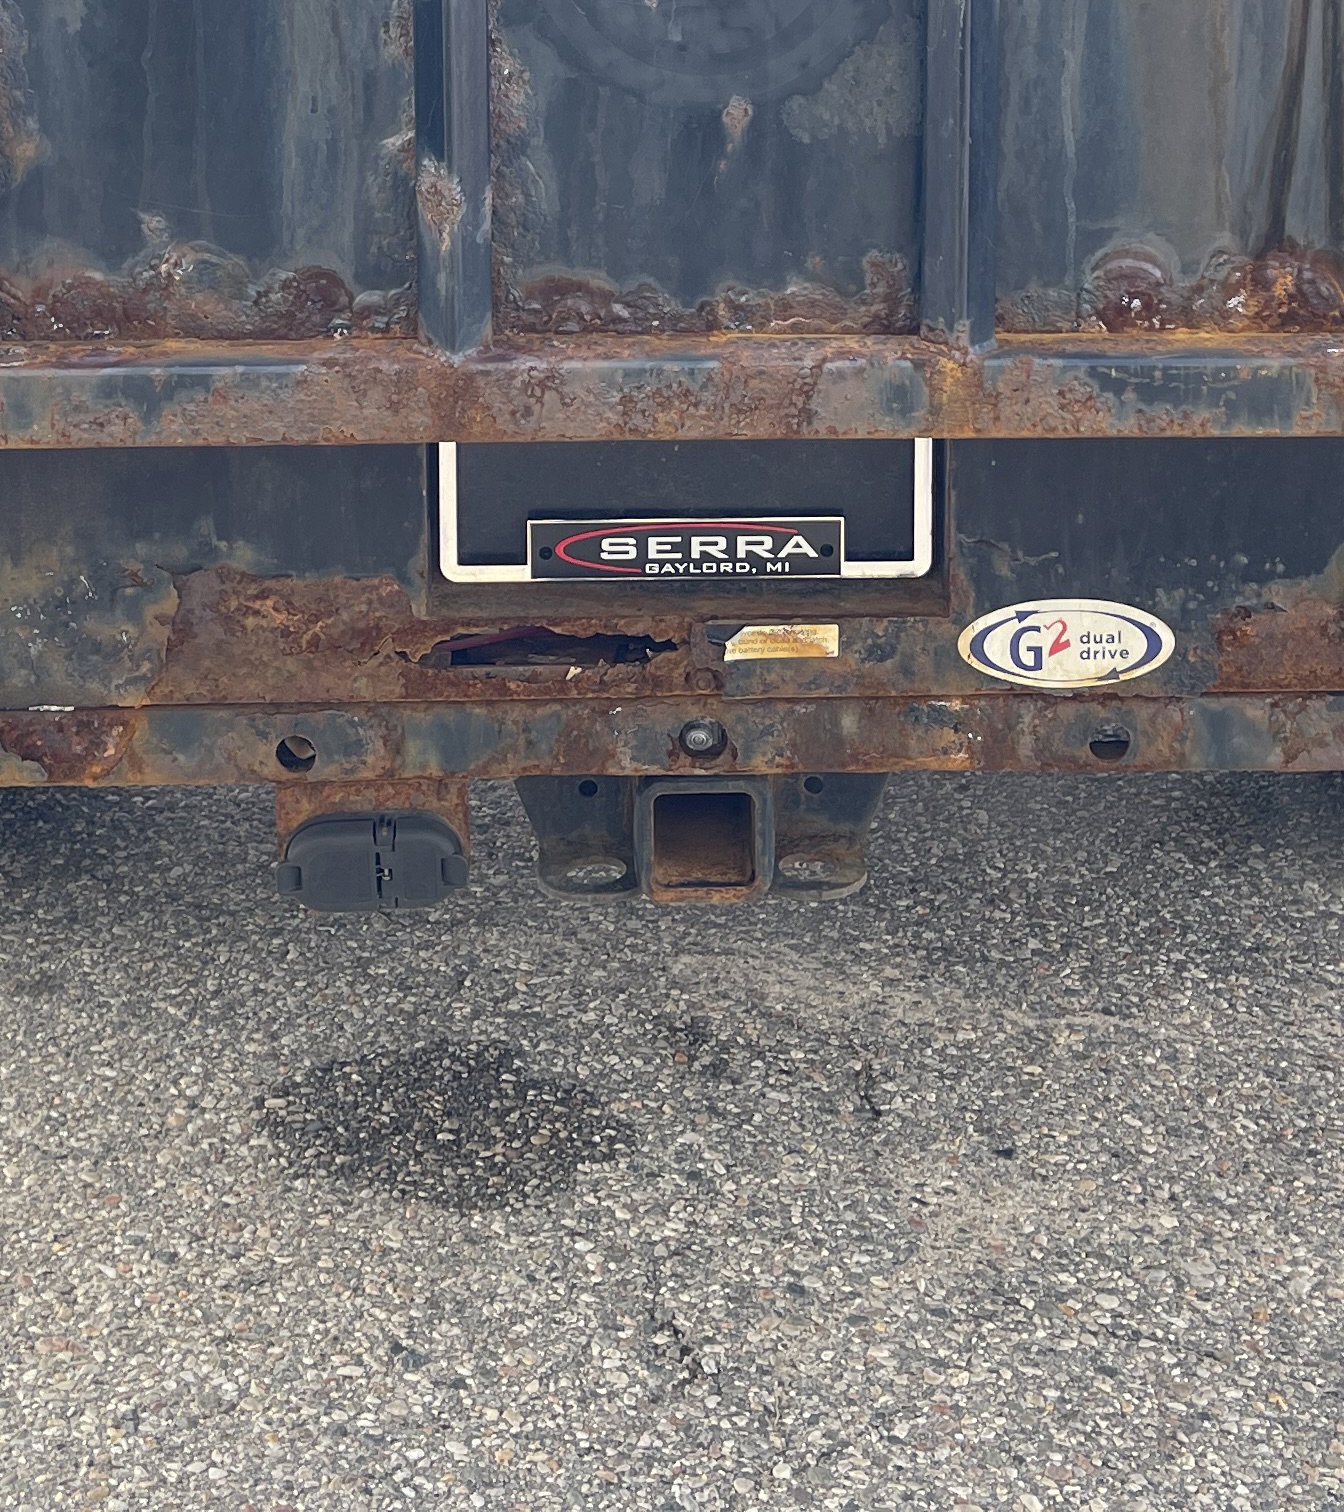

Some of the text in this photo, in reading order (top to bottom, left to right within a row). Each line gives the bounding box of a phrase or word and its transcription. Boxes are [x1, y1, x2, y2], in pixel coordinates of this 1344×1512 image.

[600, 534, 819, 560] SERRA
[645, 562, 790, 574] GAYLORD, MI
[1079, 630, 1122, 644] dual
[1079, 646, 1130, 660] drive
